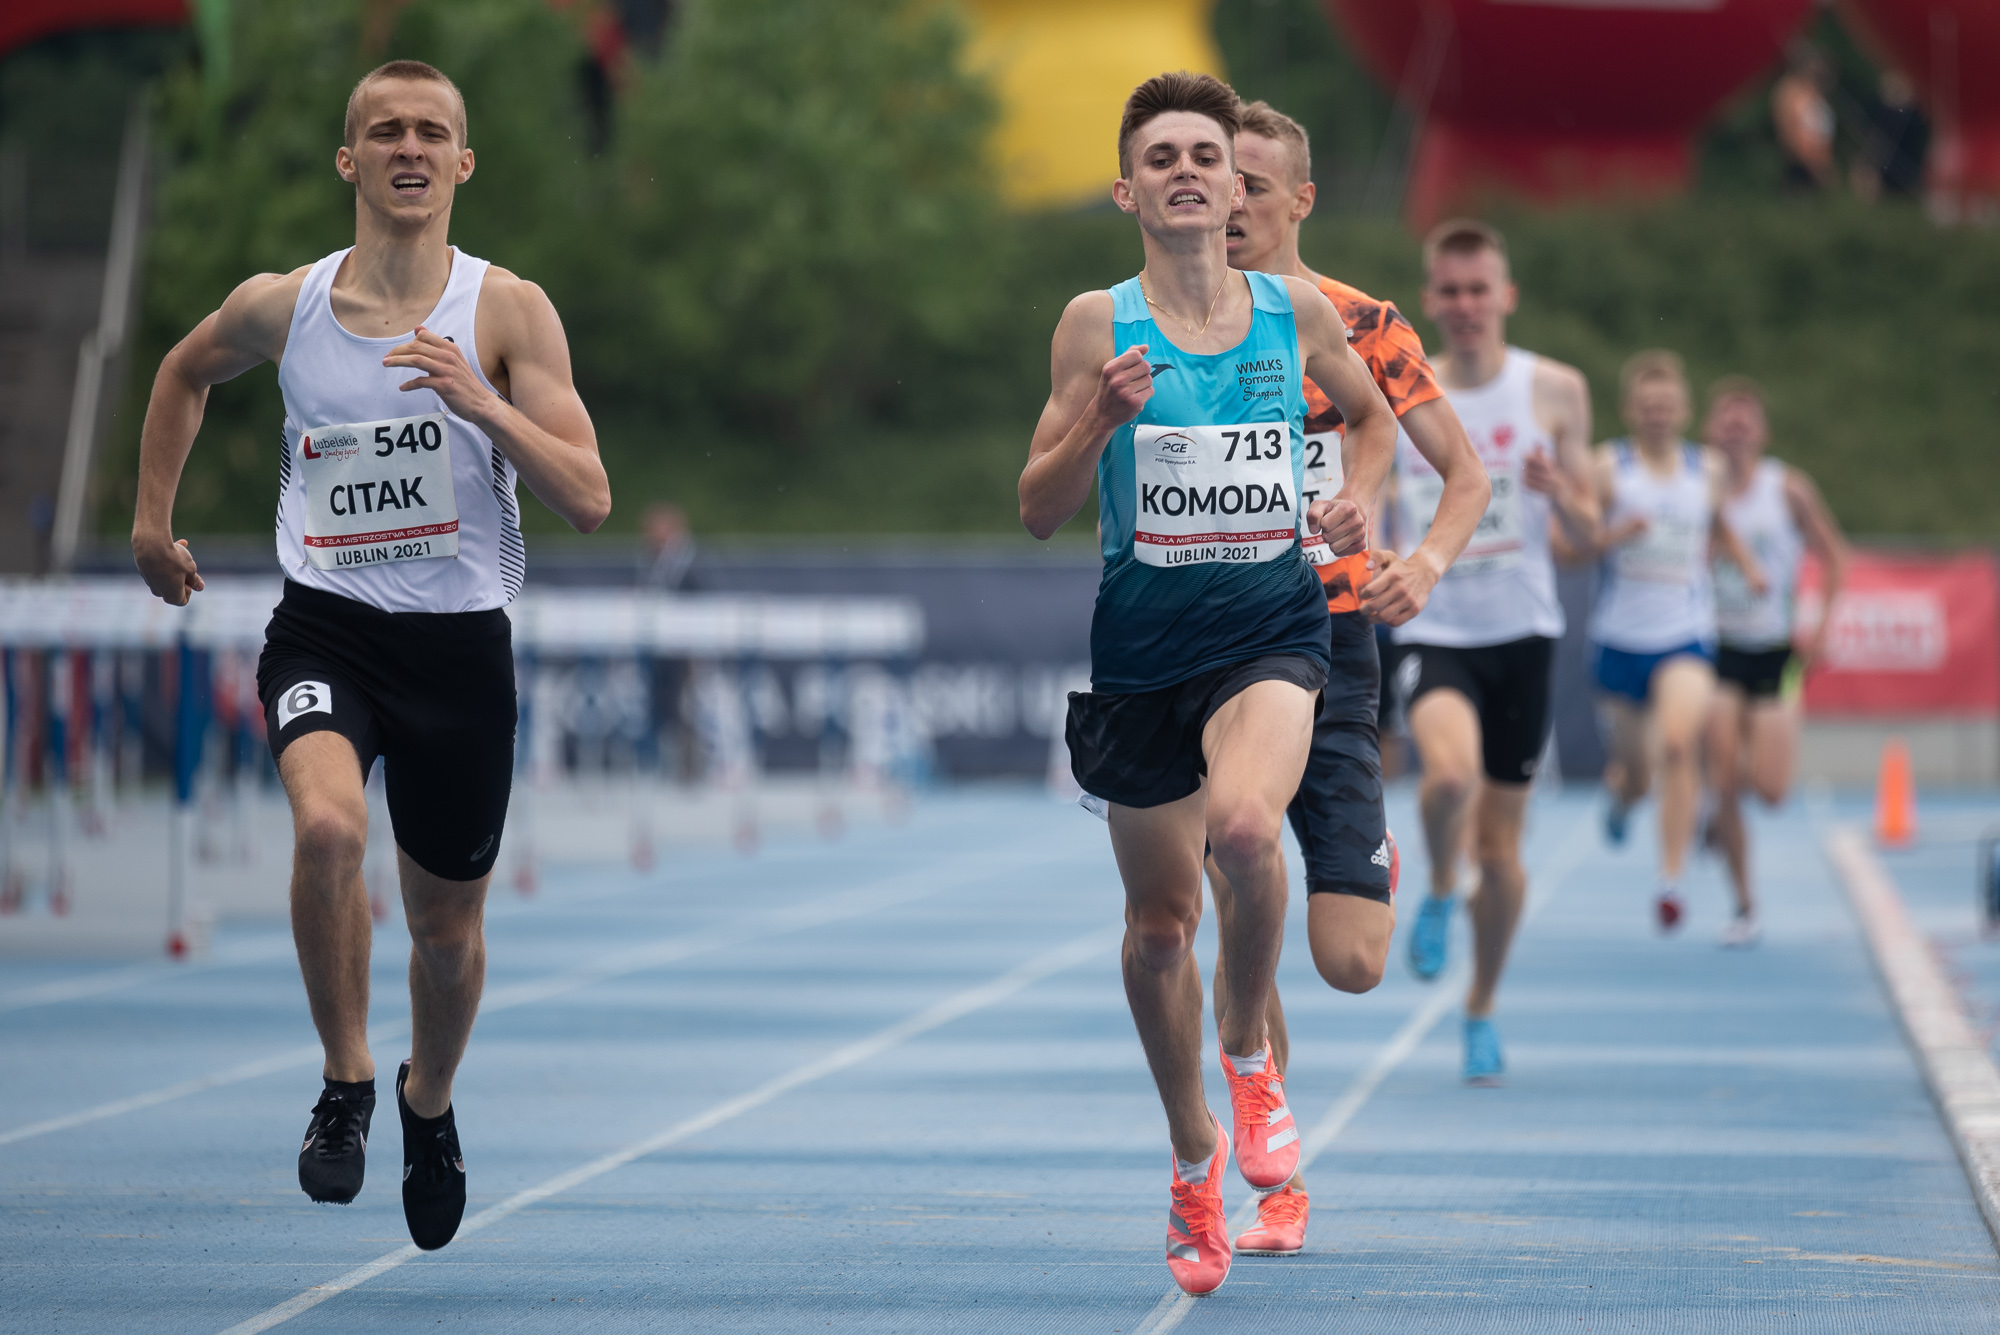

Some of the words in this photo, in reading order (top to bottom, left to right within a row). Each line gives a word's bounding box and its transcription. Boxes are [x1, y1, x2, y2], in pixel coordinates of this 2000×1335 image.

[1235, 358, 1283, 375] WMLKS
[1238, 374, 1285, 387] Pomorze
[374, 420, 442, 458] 540
[1161, 442, 1189, 453] PGE
[1220, 429, 1282, 462] 713
[1303, 440, 1326, 470] 2
[329, 475, 428, 517] CITAK
[1141, 482, 1291, 517] KOMODA
[342, 531, 406, 544] MISTRZOSTWA
[406, 526, 439, 537] POLSKI
[439, 523, 457, 532] U20
[1152, 535, 1175, 544] PZLA
[1176, 534, 1238, 544] MISTRZOSTWA
[1239, 532, 1269, 541] POLSKI
[1270, 530, 1288, 538] U20
[335, 546, 389, 566] LUBLIN
[393, 541, 431, 559] 2021
[1166, 546, 1217, 564] LUBLIN
[1221, 546, 1258, 560] 2021
[287, 684, 319, 715] 6
